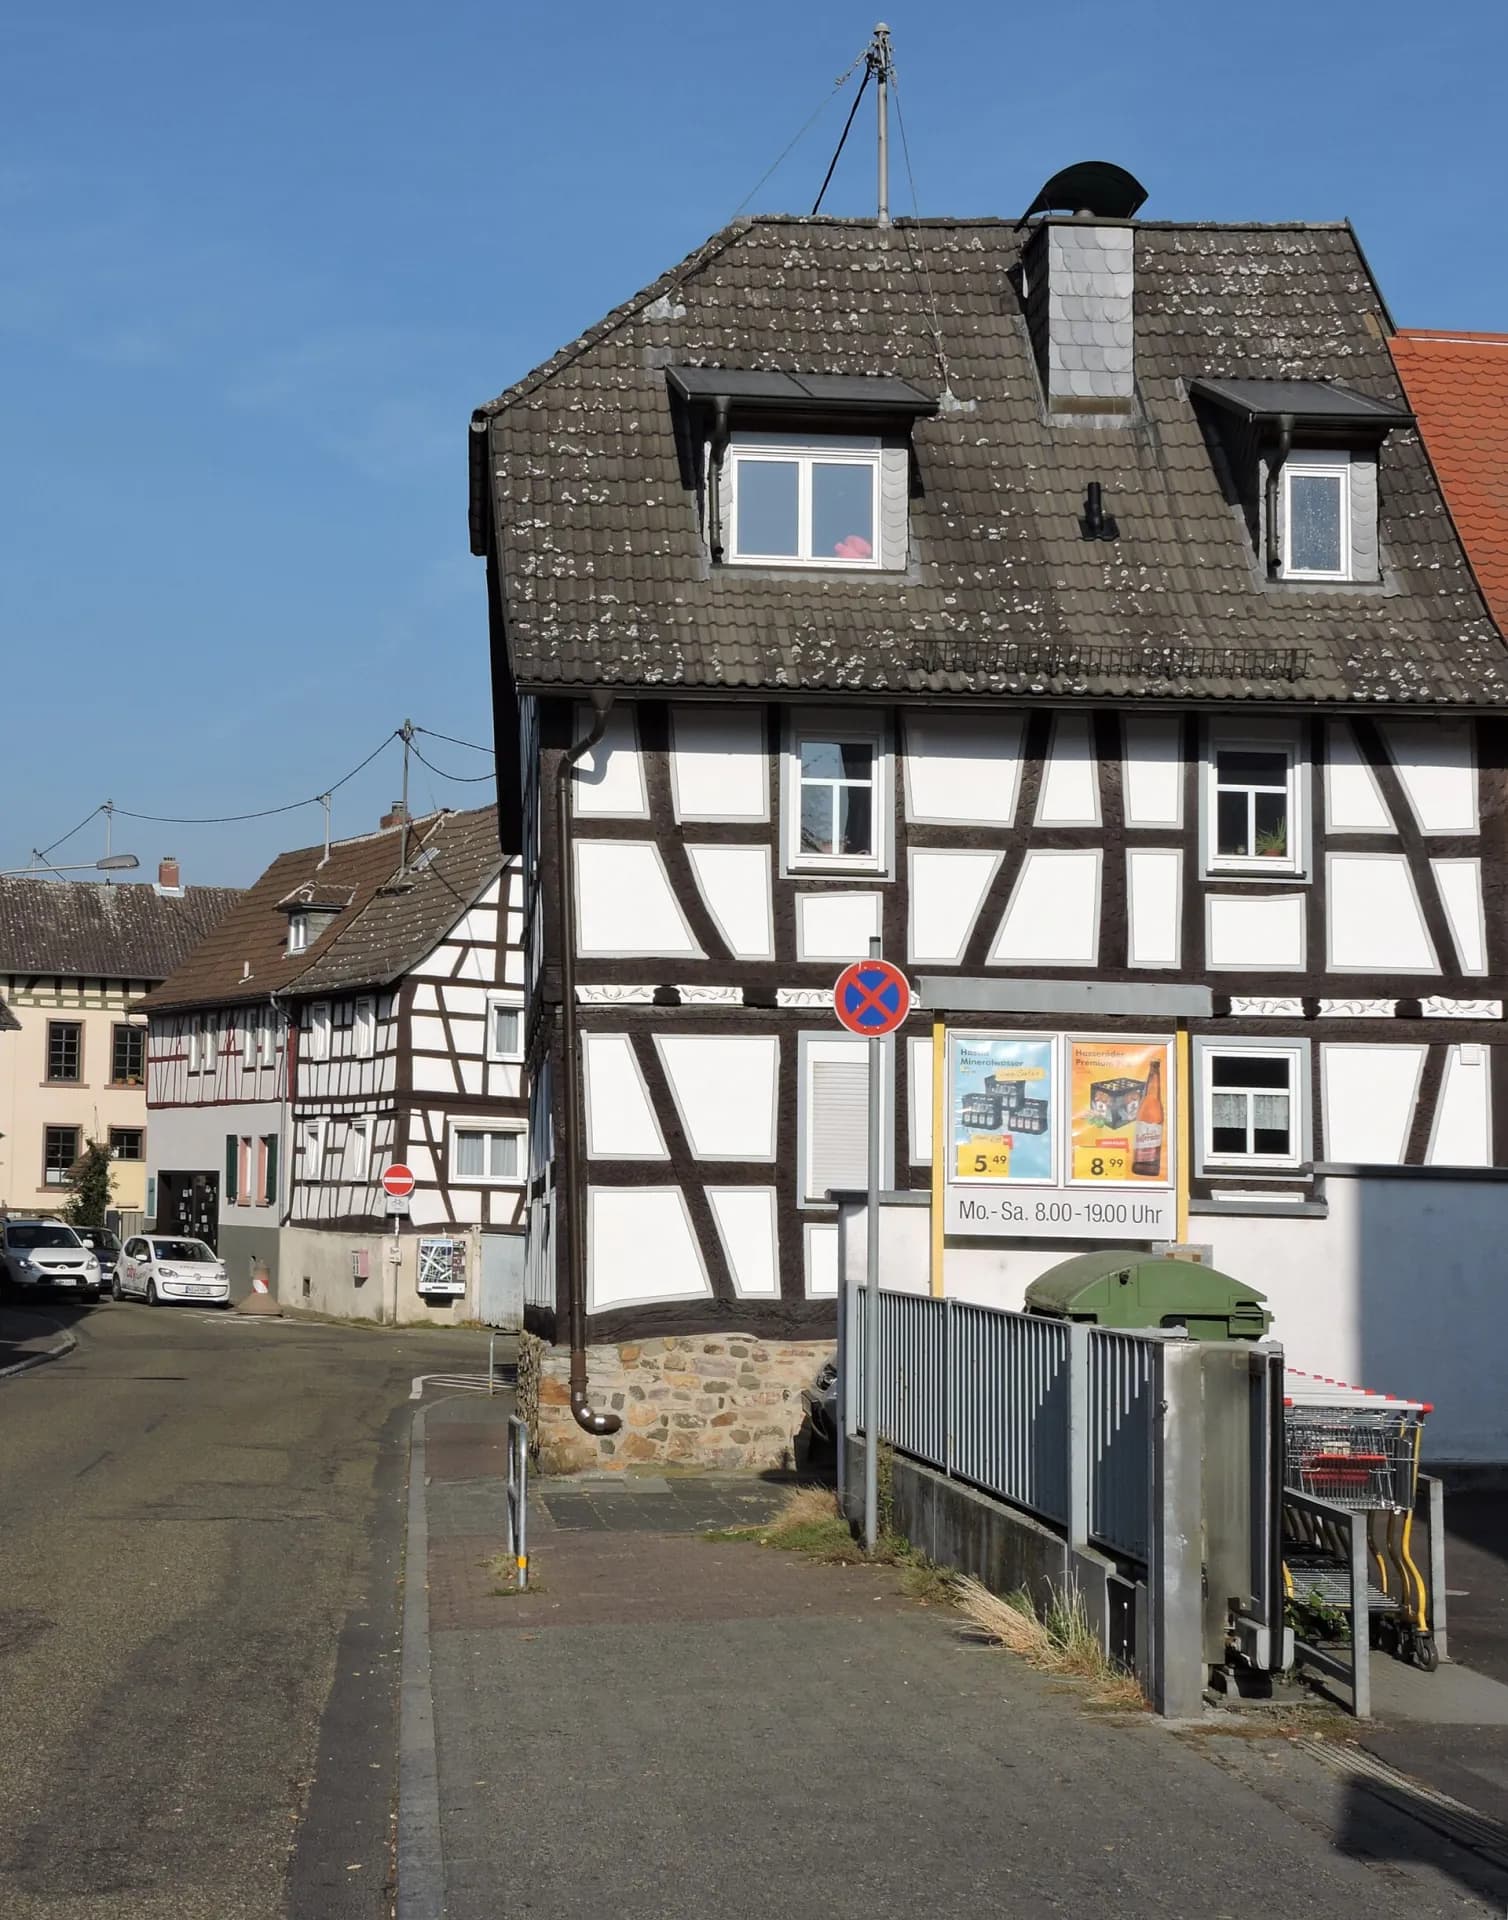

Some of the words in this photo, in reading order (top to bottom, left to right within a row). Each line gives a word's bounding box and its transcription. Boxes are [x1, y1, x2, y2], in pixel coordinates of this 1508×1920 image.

[960, 1058, 1024, 1067] Mineralwasser
[974, 1154, 1007, 1173] 5.49
[1090, 1157, 1124, 1176] 8.99
[1132, 1204, 1163, 1224] Uhr
